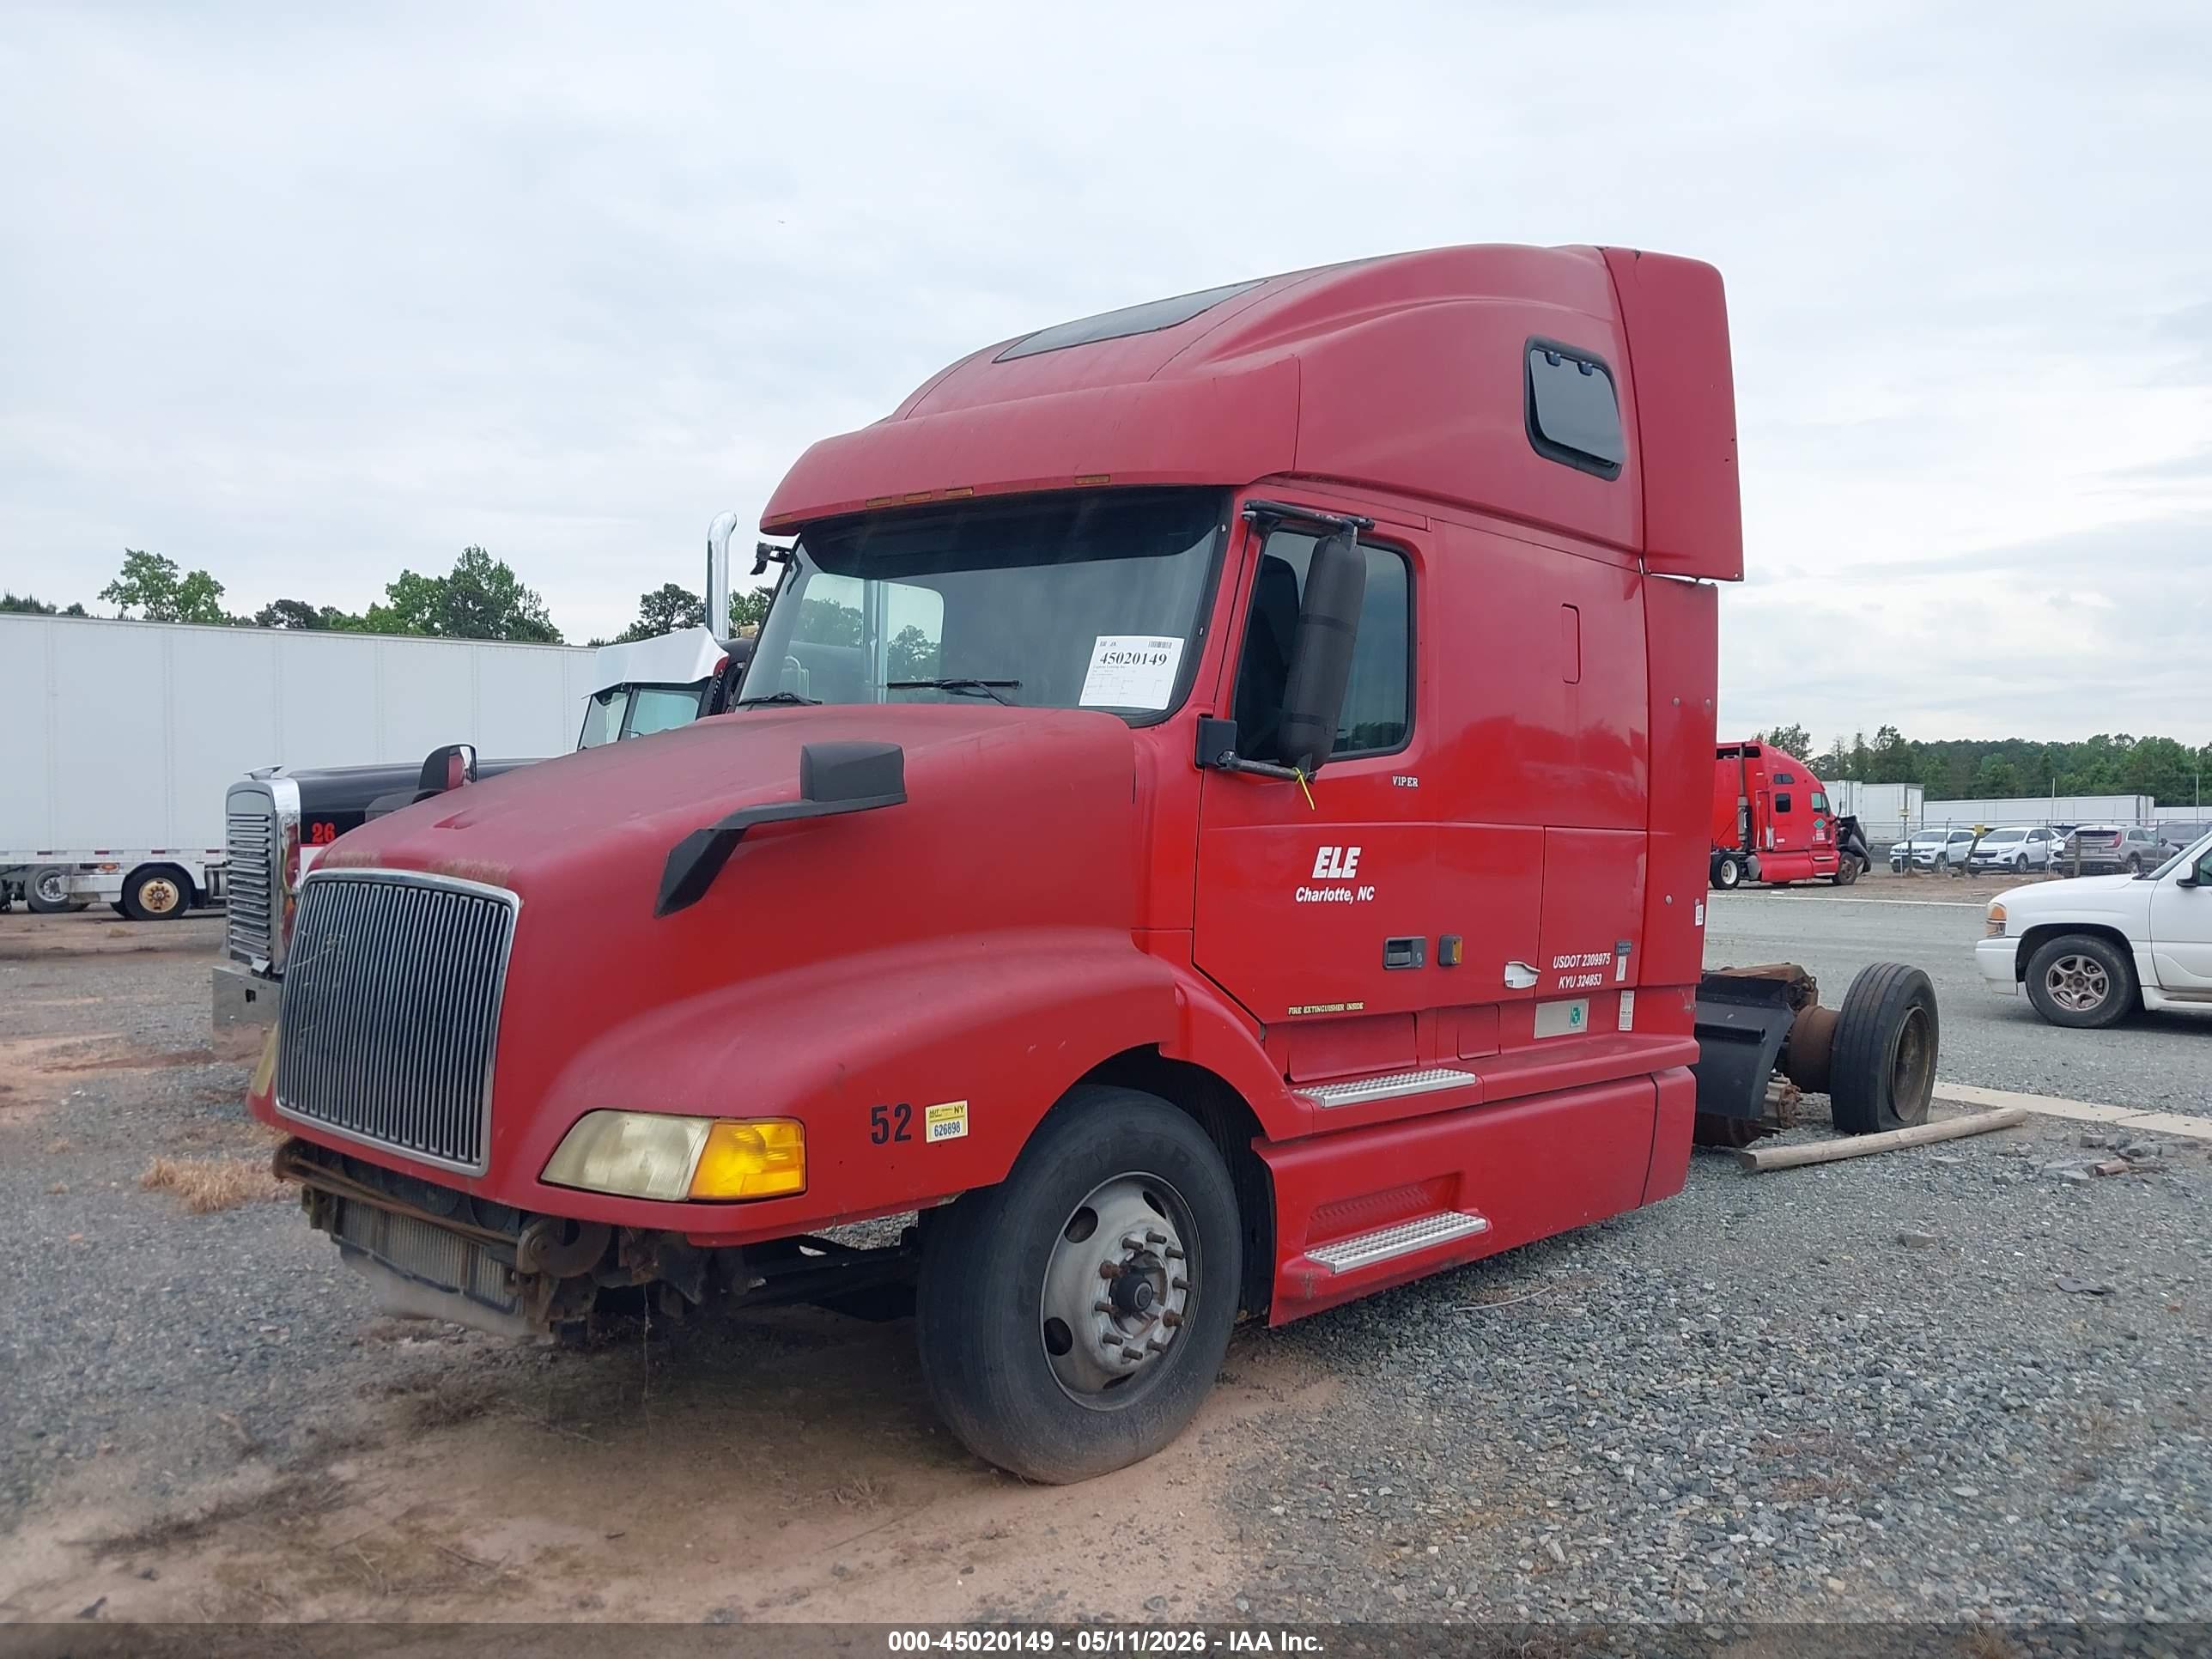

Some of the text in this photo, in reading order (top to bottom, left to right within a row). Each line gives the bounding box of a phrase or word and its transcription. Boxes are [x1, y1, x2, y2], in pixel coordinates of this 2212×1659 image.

[1099, 652, 1167, 666] 45020149
[1392, 775, 1419, 787] VIPER
[312, 822, 336, 843] 26
[1311, 846, 1362, 878] ELE
[1295, 885, 1376, 905] Charlotte, NC
[1553, 952, 1611, 969] USDOT 2309975
[1558, 973, 1602, 989] KYU 324853
[1288, 1001, 1364, 1015] FIRE EXTINGUISHER INSIDE
[954, 1105, 964, 1114] NY
[871, 1103, 912, 1145] 52
[934, 1121, 961, 1137] 626898
